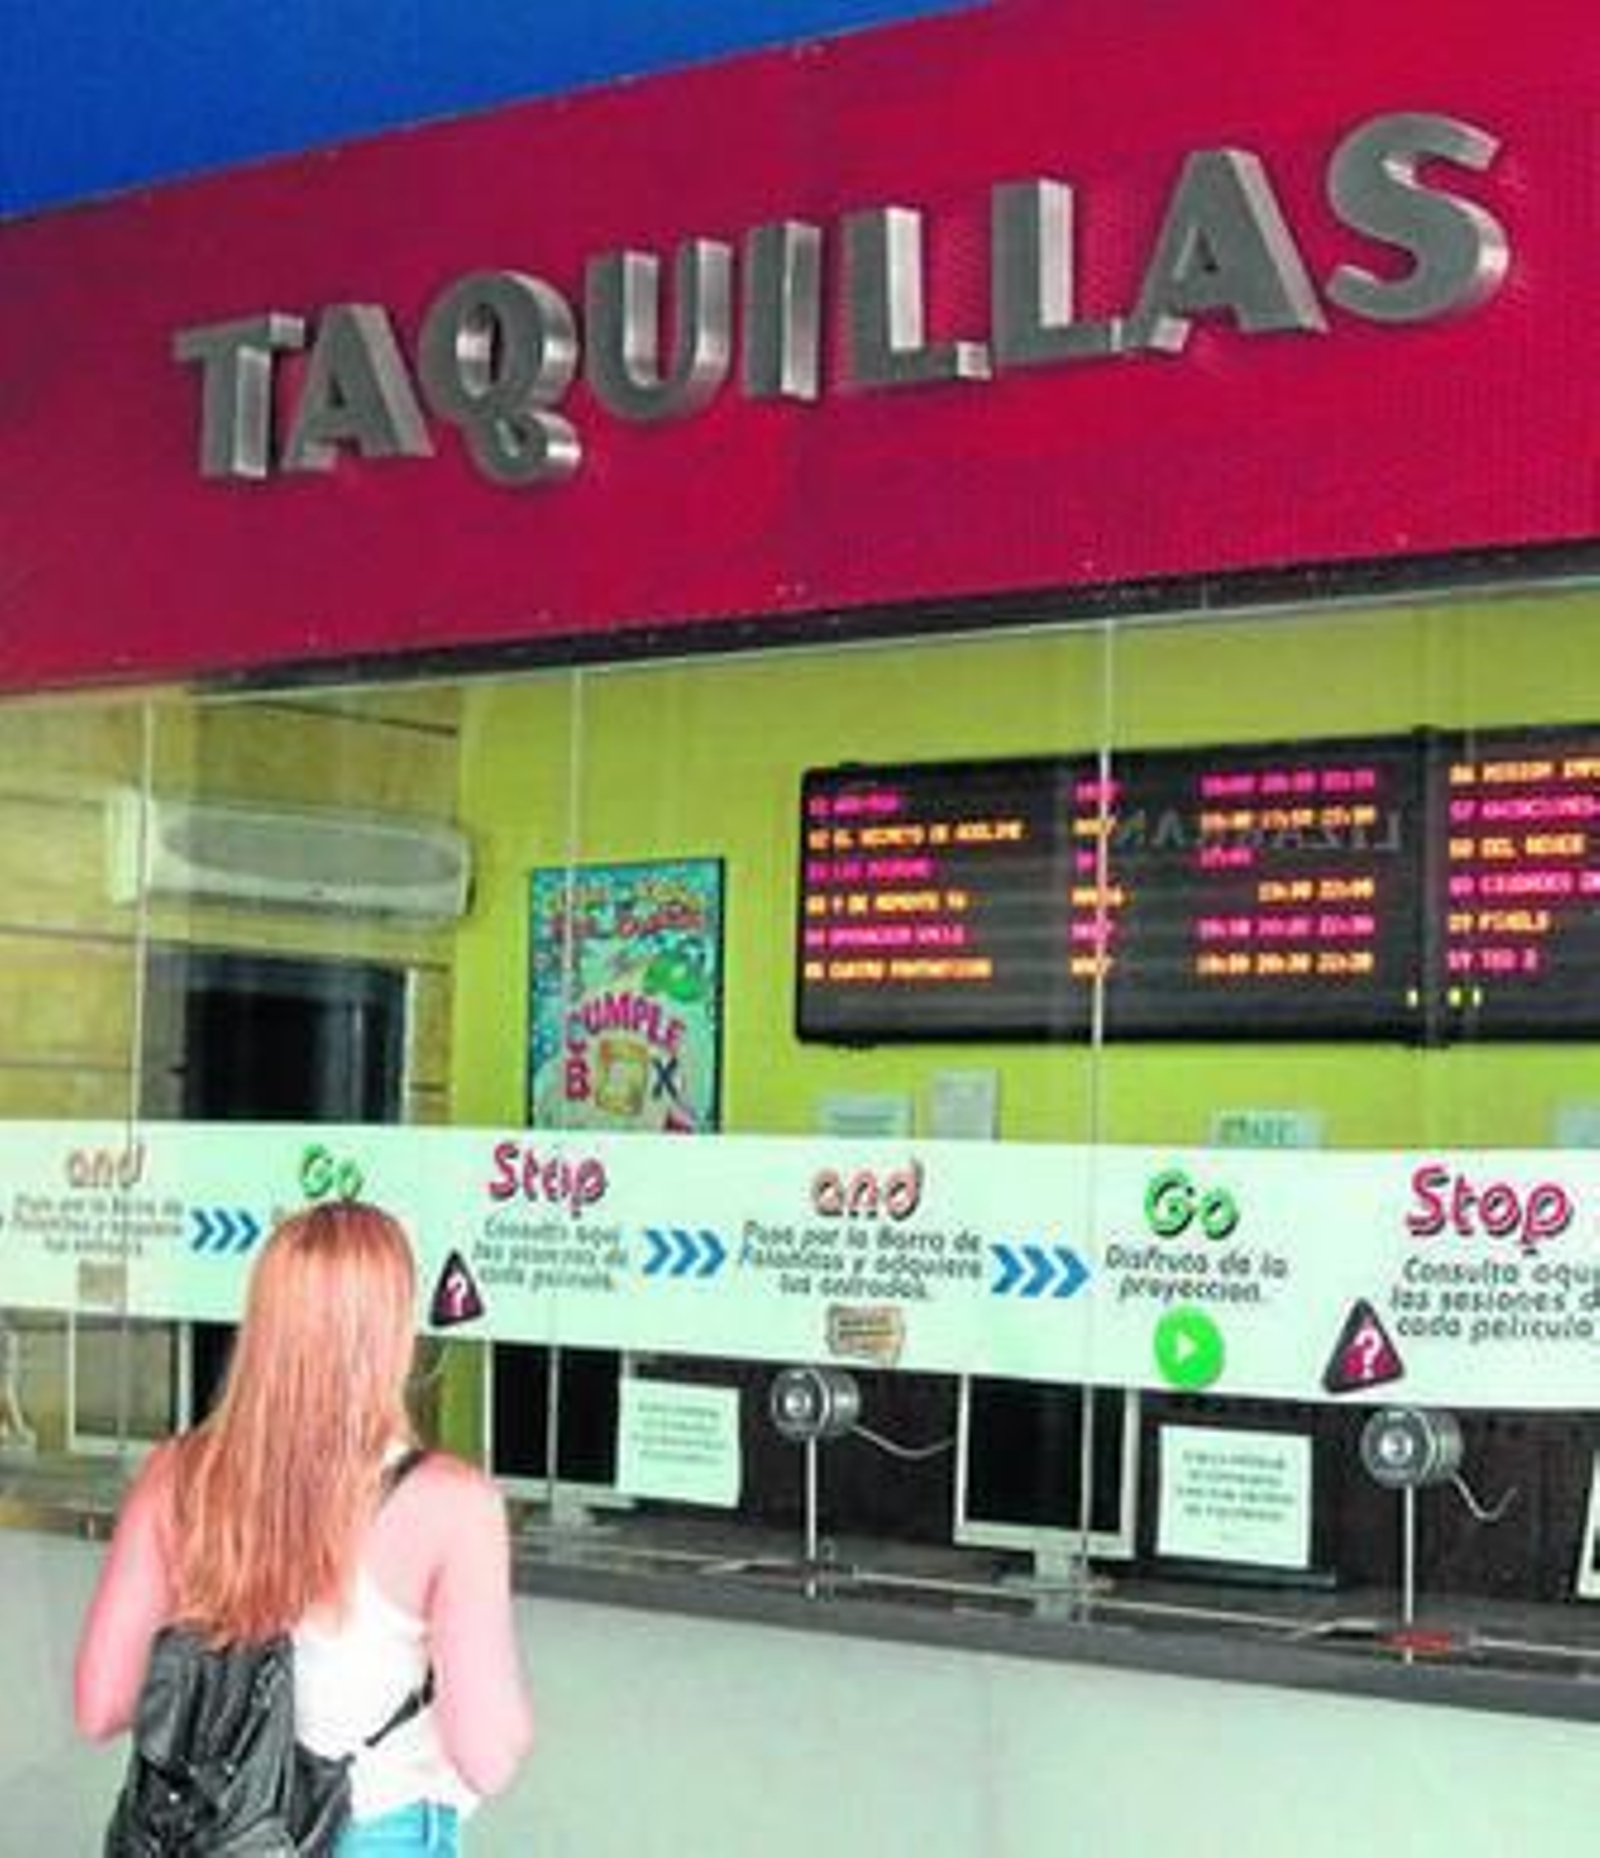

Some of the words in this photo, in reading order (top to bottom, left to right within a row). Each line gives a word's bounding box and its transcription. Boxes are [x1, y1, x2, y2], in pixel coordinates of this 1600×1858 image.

[173, 111, 1511, 487] TAQUILLAS
[565, 991, 686, 1055] CUMPLE
[67, 1143, 145, 1190] and
[302, 1143, 365, 1201] Go
[812, 1156, 925, 1222] and
[1144, 1168, 1241, 1241] Go
[1405, 1163, 1575, 1257] Stop
[800, 1227, 840, 1252] por
[877, 1226, 946, 1252] Barra
[953, 1229, 983, 1254] de
[1218, 1249, 1252, 1277] de
[1260, 1252, 1289, 1280] la
[1403, 1256, 1519, 1285] Consulta
[1391, 1286, 1430, 1312] las
[1441, 1291, 1566, 1312] sesiones
[1397, 1313, 1461, 1337] cada
